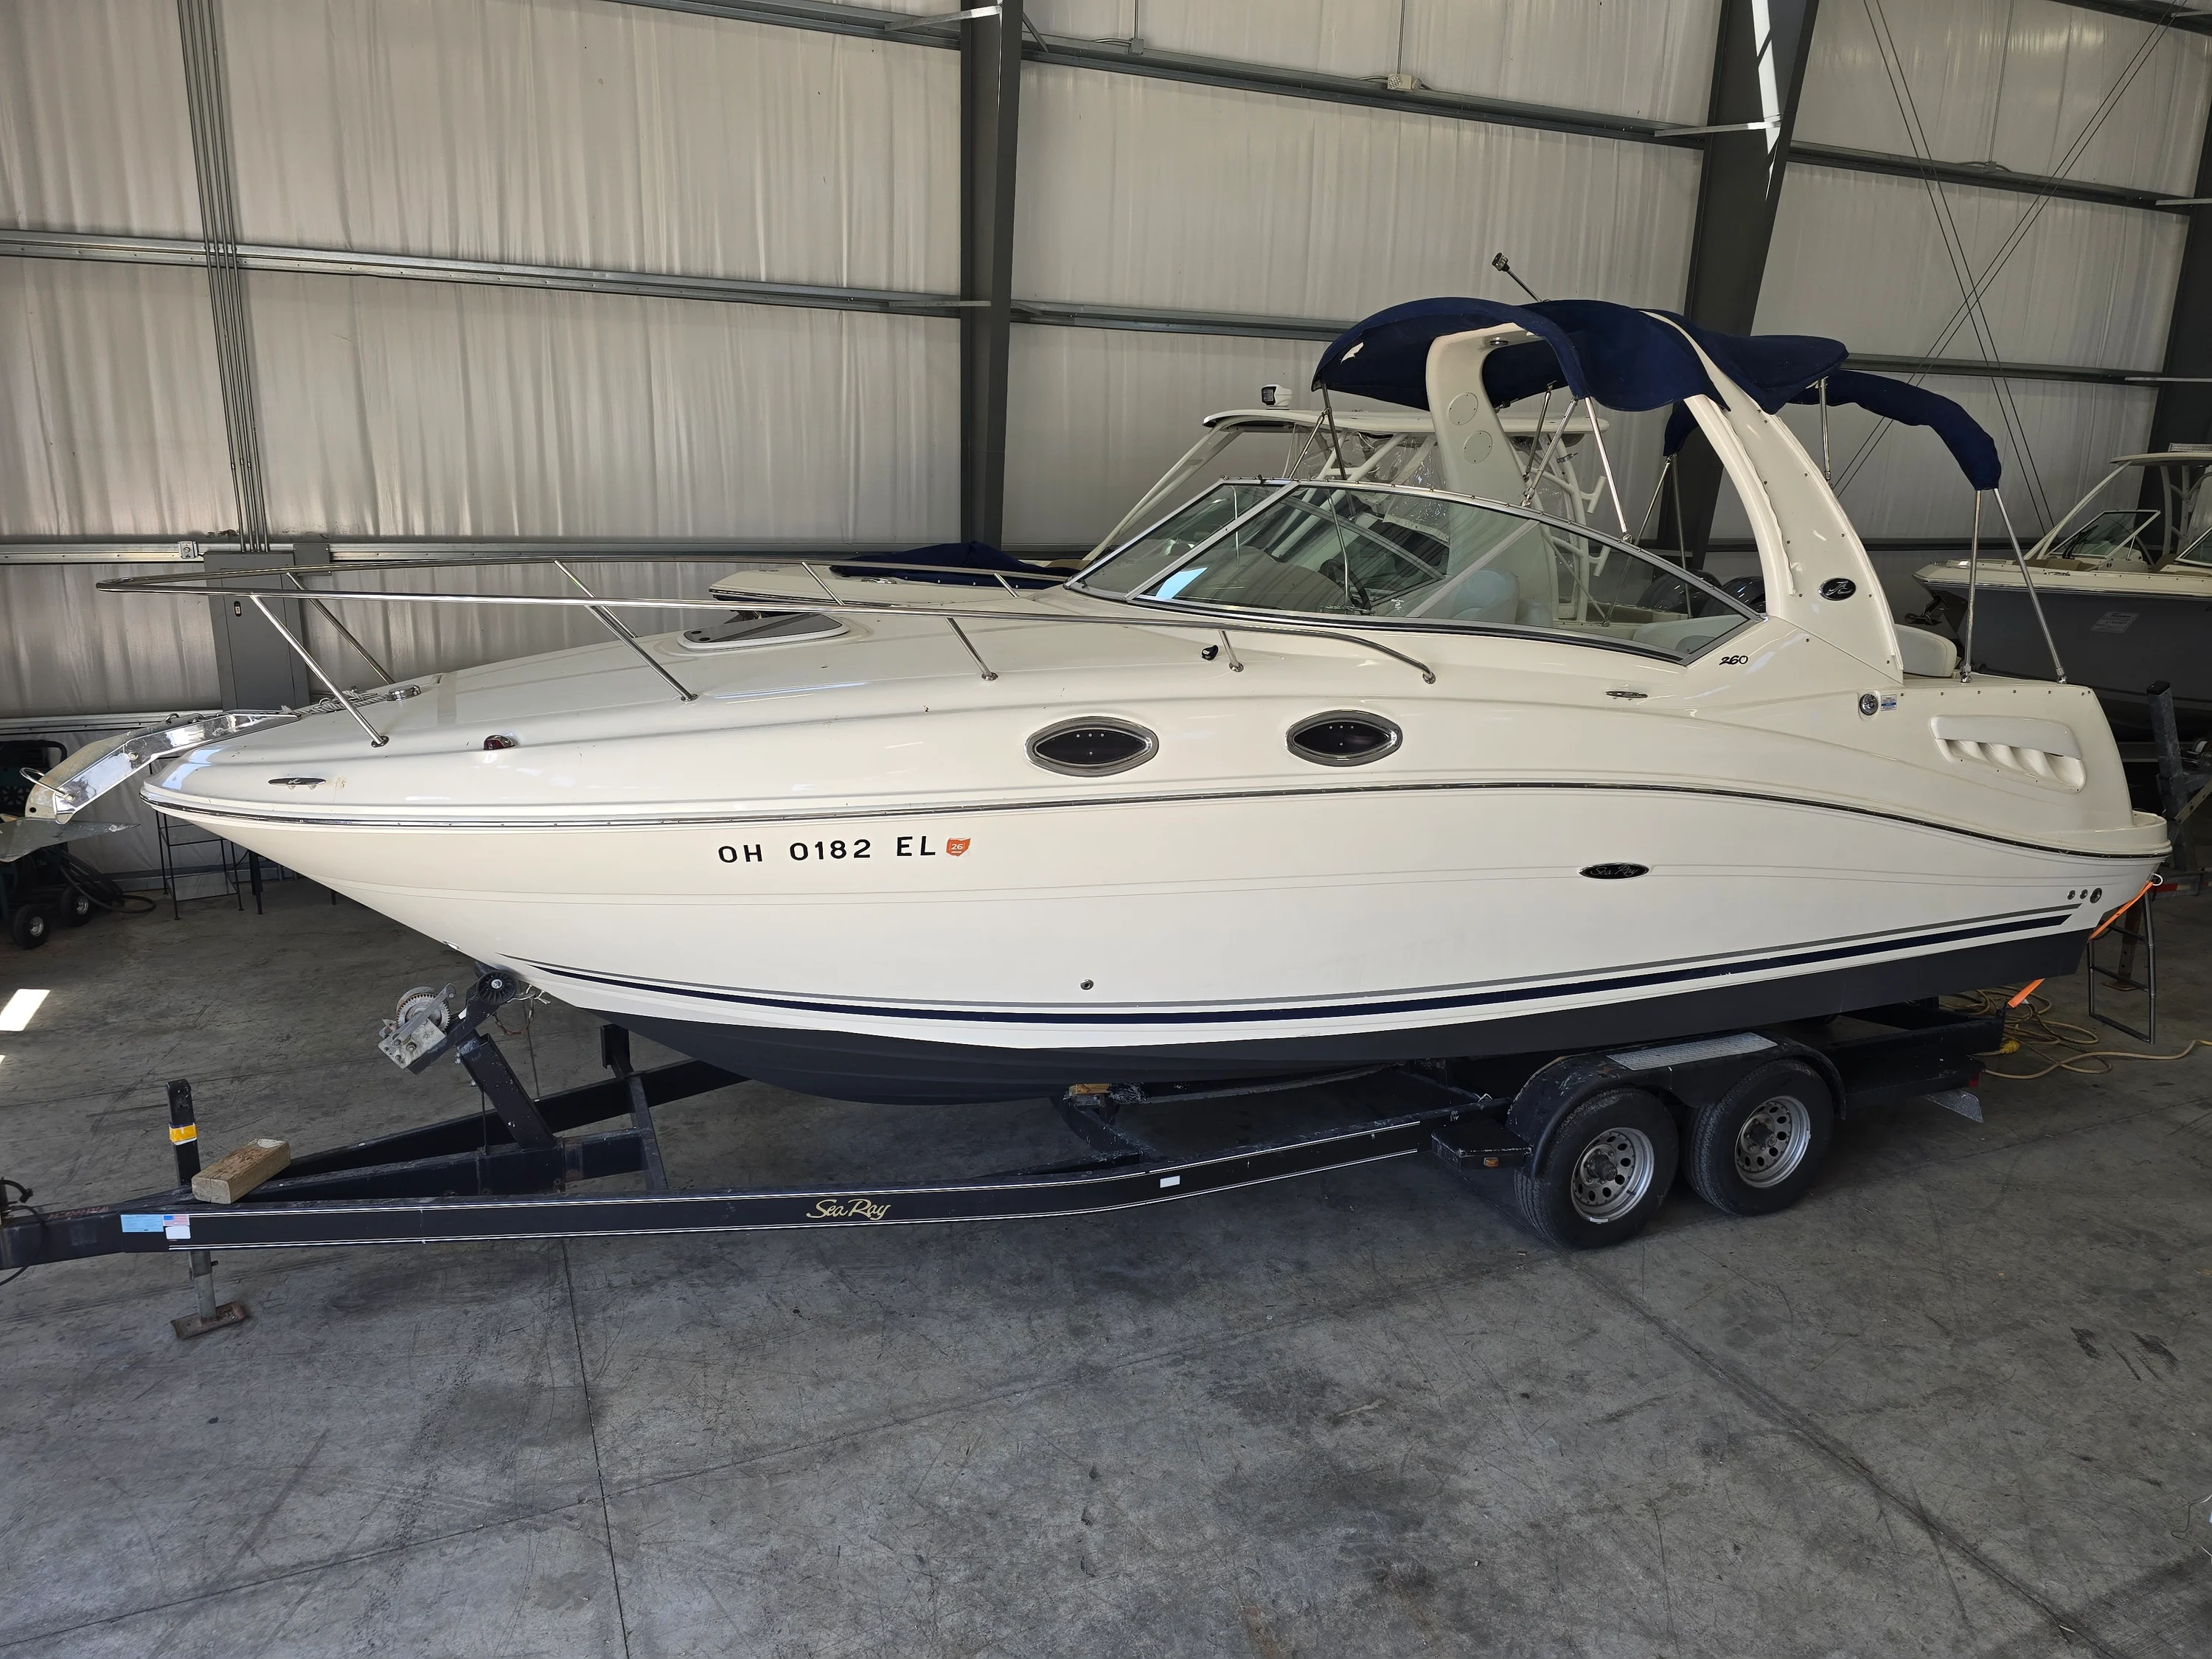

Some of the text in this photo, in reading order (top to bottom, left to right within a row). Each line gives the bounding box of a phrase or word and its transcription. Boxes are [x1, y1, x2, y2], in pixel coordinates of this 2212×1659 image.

[1719, 655, 1748, 665] 260
[718, 835, 936, 863] OH 0182 EL
[1590, 866, 1639, 877] Sea Ray
[806, 1198, 891, 1220] Sea Ray
